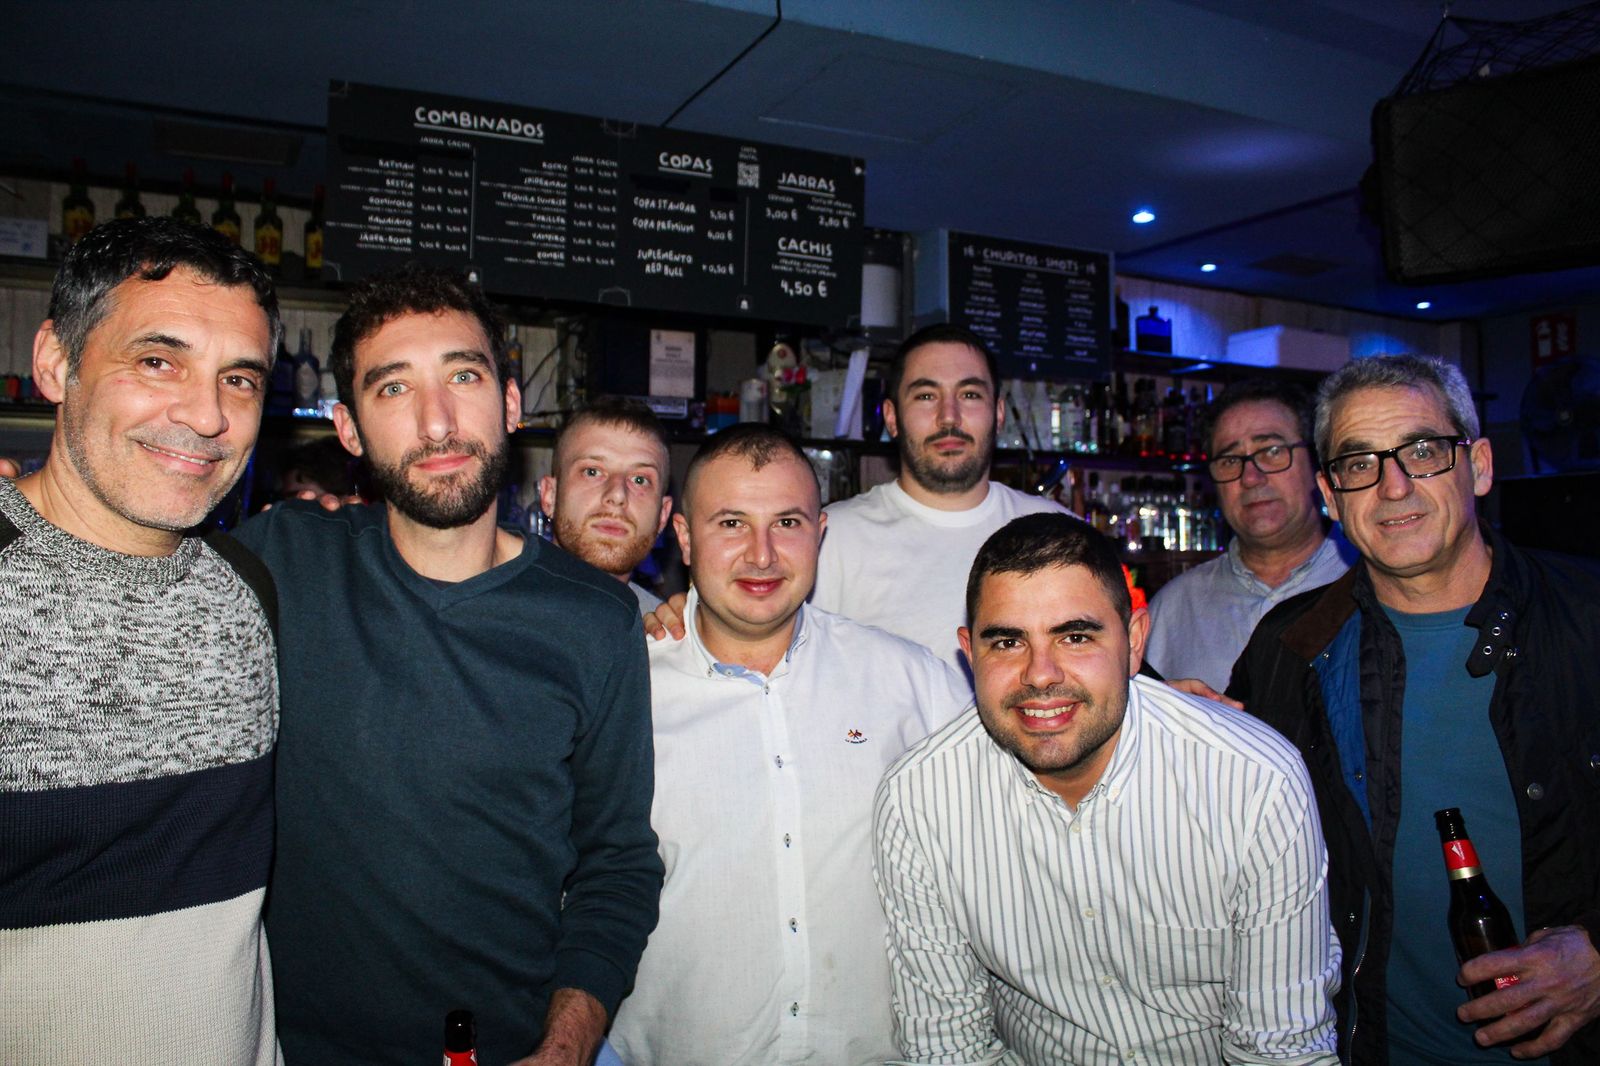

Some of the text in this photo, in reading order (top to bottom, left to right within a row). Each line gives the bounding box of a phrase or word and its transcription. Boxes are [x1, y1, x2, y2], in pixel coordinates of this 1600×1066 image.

[415, 107, 544, 138] COMBINADOS
[659, 152, 713, 173] COPAS
[778, 172, 836, 192] JARRAS
[502, 192, 534, 203] TEQUILA
[633, 196, 656, 209] COPA
[791, 208, 798, 222] €
[842, 216, 849, 229] €
[632, 216, 695, 234] COPA PREMIUM
[777, 237, 832, 257] CACHIS
[637, 249, 693, 264] SUPLEMENTO
[983, 248, 1038, 266] CHUPITOS
[645, 263, 683, 277] RED BULL
[780, 280, 828, 298] 4,50 €
